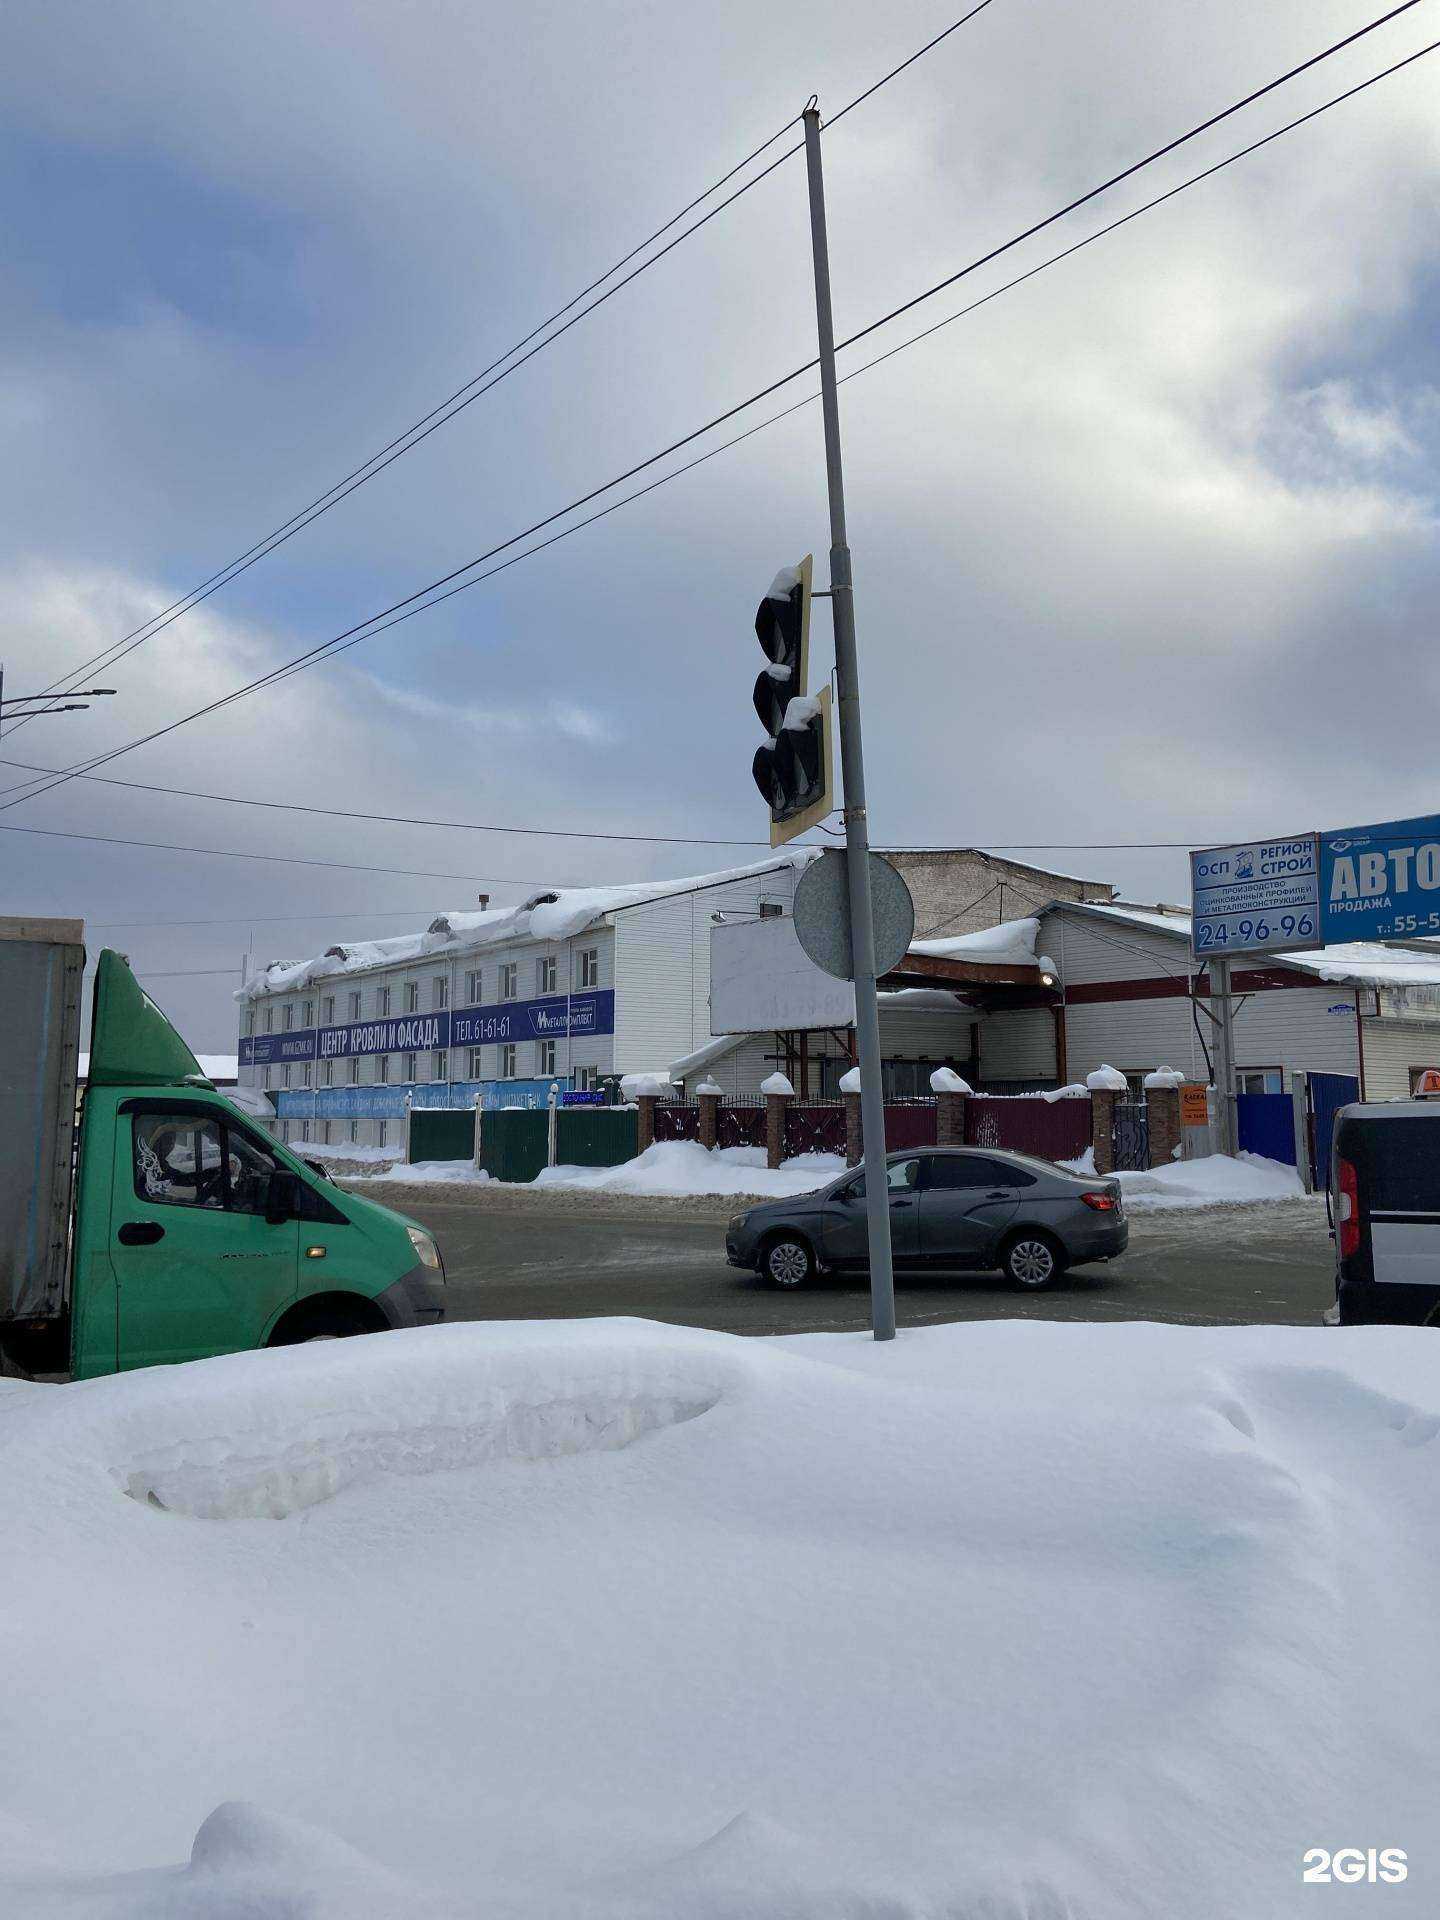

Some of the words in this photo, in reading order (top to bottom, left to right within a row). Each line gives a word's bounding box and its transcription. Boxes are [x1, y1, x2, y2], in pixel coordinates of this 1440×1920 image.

[1261, 841, 1313, 859] РЕГИОН
[1199, 861, 1230, 876] ОСП
[1261, 855, 1313, 875] СТРОЙ
[1222, 881, 1287, 895] ПРОИЗВОДСТВО
[1265, 885, 1313, 898] ПРОФИЛЕЙ
[1212, 895, 1307, 913] МЕТАЛЛОКОНСТРУКЦИИ
[1329, 897, 1392, 914] ПРОДАЖА
[1199, 913, 1314, 947] 24-96-96
[321, 1029, 348, 1058] ЦЕНТР
[350, 1024, 387, 1053] КРОВЛИ
[388, 1023, 396, 1049] И
[397, 1018, 439, 1050] ФАСАДА
[455, 1019, 474, 1042] ТЕЛ.
[474, 1016, 511, 1040] 61-61-61
